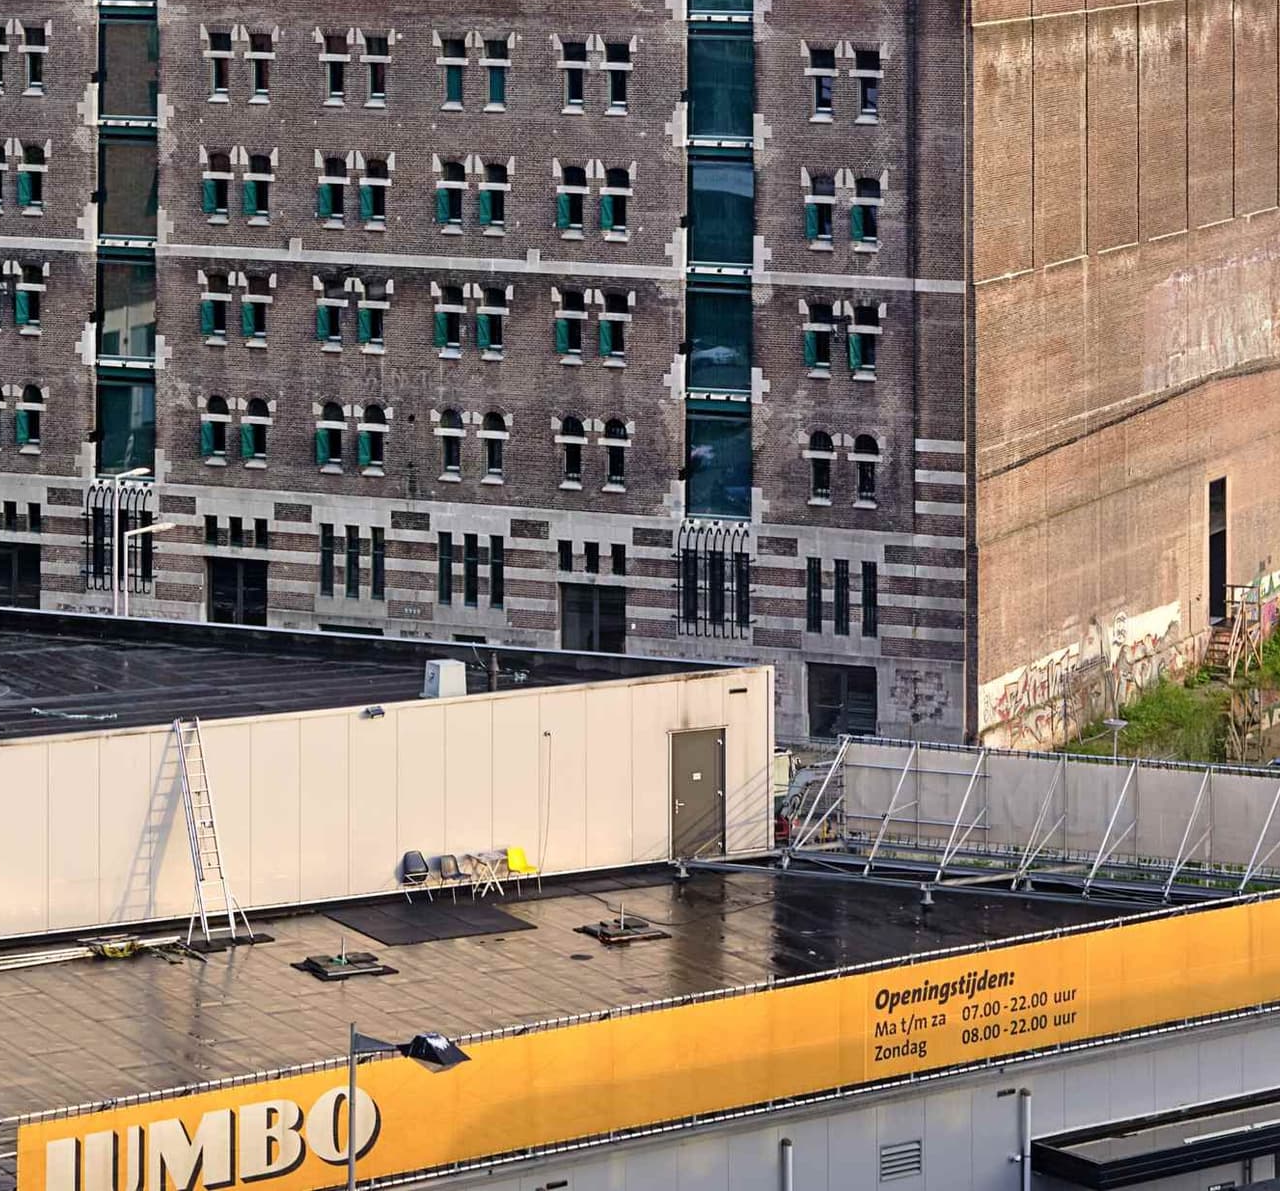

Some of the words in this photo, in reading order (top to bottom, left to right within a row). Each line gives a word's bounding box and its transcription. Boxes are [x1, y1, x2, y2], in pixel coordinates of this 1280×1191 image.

[875, 969, 1015, 1014] Openingstijden:
[875, 1021, 897, 1037] Ma
[901, 1014, 927, 1036] t/m
[931, 1013, 946, 1027] za
[1053, 988, 1077, 1004] uur
[875, 1039, 927, 1062] Zondag
[1053, 1011, 1077, 1027] uur
